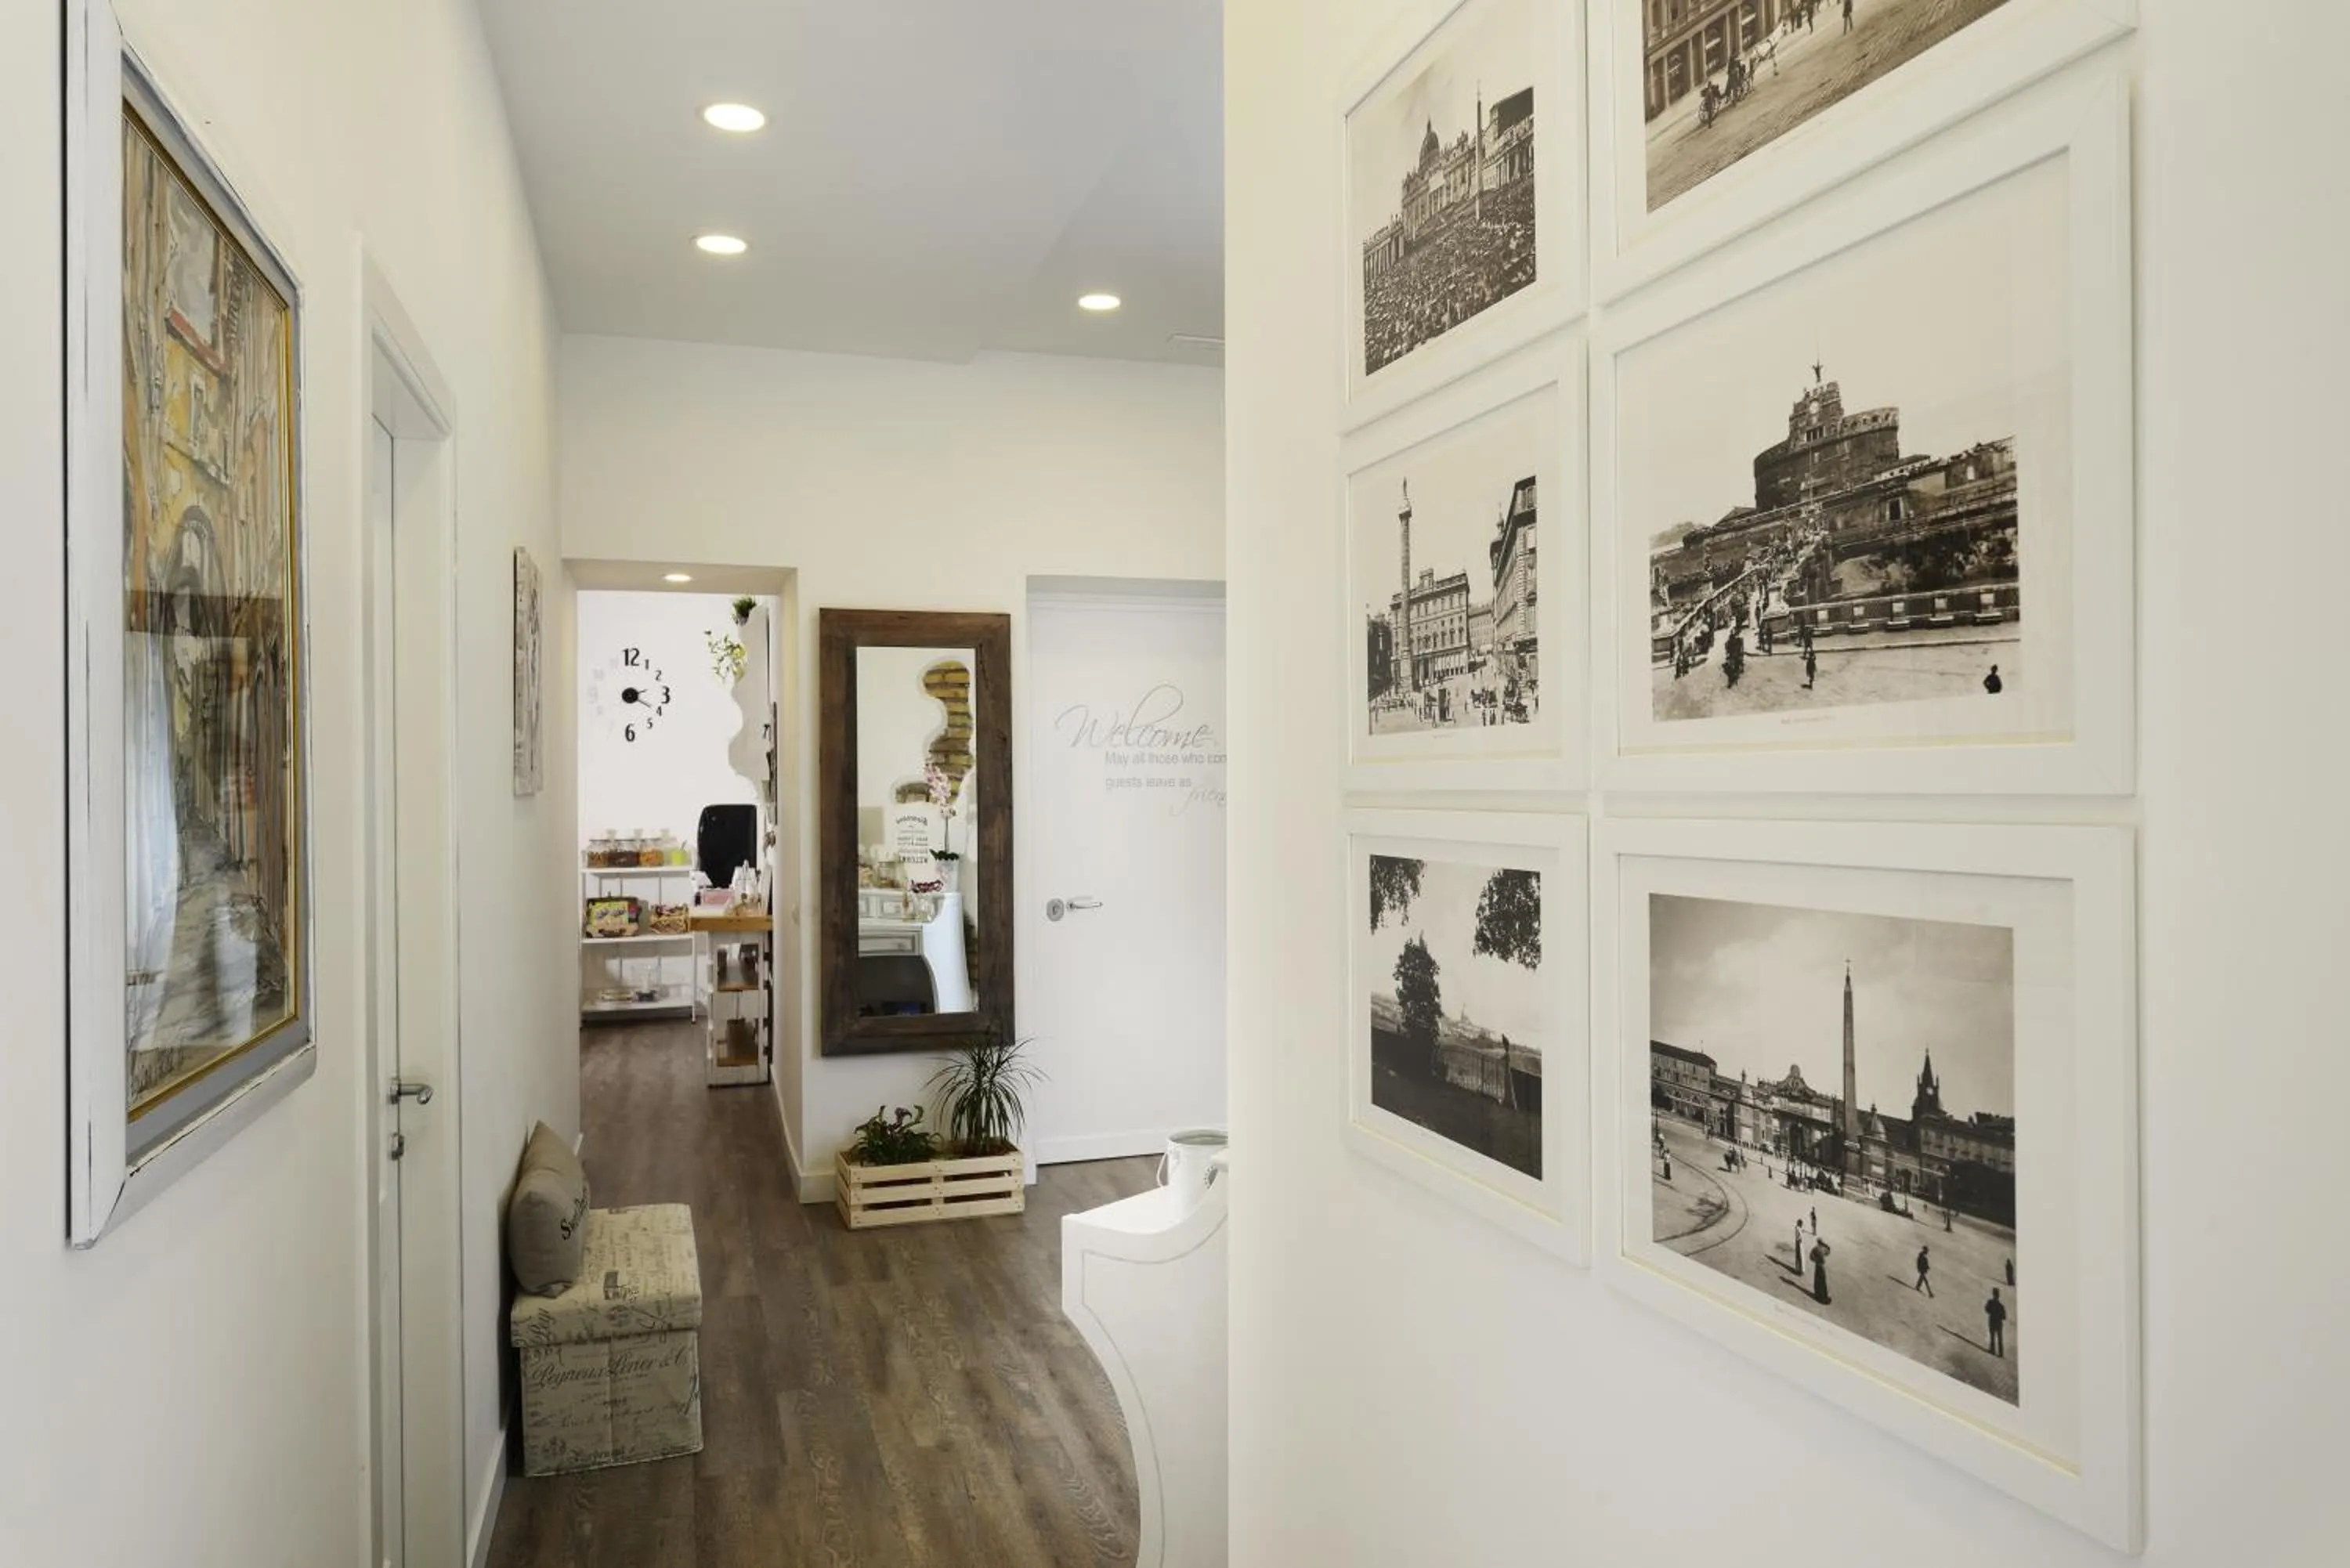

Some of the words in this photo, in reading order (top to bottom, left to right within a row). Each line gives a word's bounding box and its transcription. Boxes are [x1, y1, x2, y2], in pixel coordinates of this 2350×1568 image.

[621, 648, 640, 667] 12
[645, 659, 650, 670] 1
[655, 670, 662, 681] 2
[661, 685, 671, 704] 3
[656, 706, 662, 717] 4
[1054, 683, 1214, 750] Welcome
[646, 717, 653, 729] 5
[624, 723, 635, 742] 6
[1105, 751, 1128, 768] May
[1132, 751, 1145, 764] all
[1148, 751, 1178, 764] those
[1181, 752, 1205, 764] who
[1207, 753, 1227, 764] com
[1105, 777, 1143, 790] guests
[1146, 777, 1176, 788] leave
[1179, 777, 1191, 788] as
